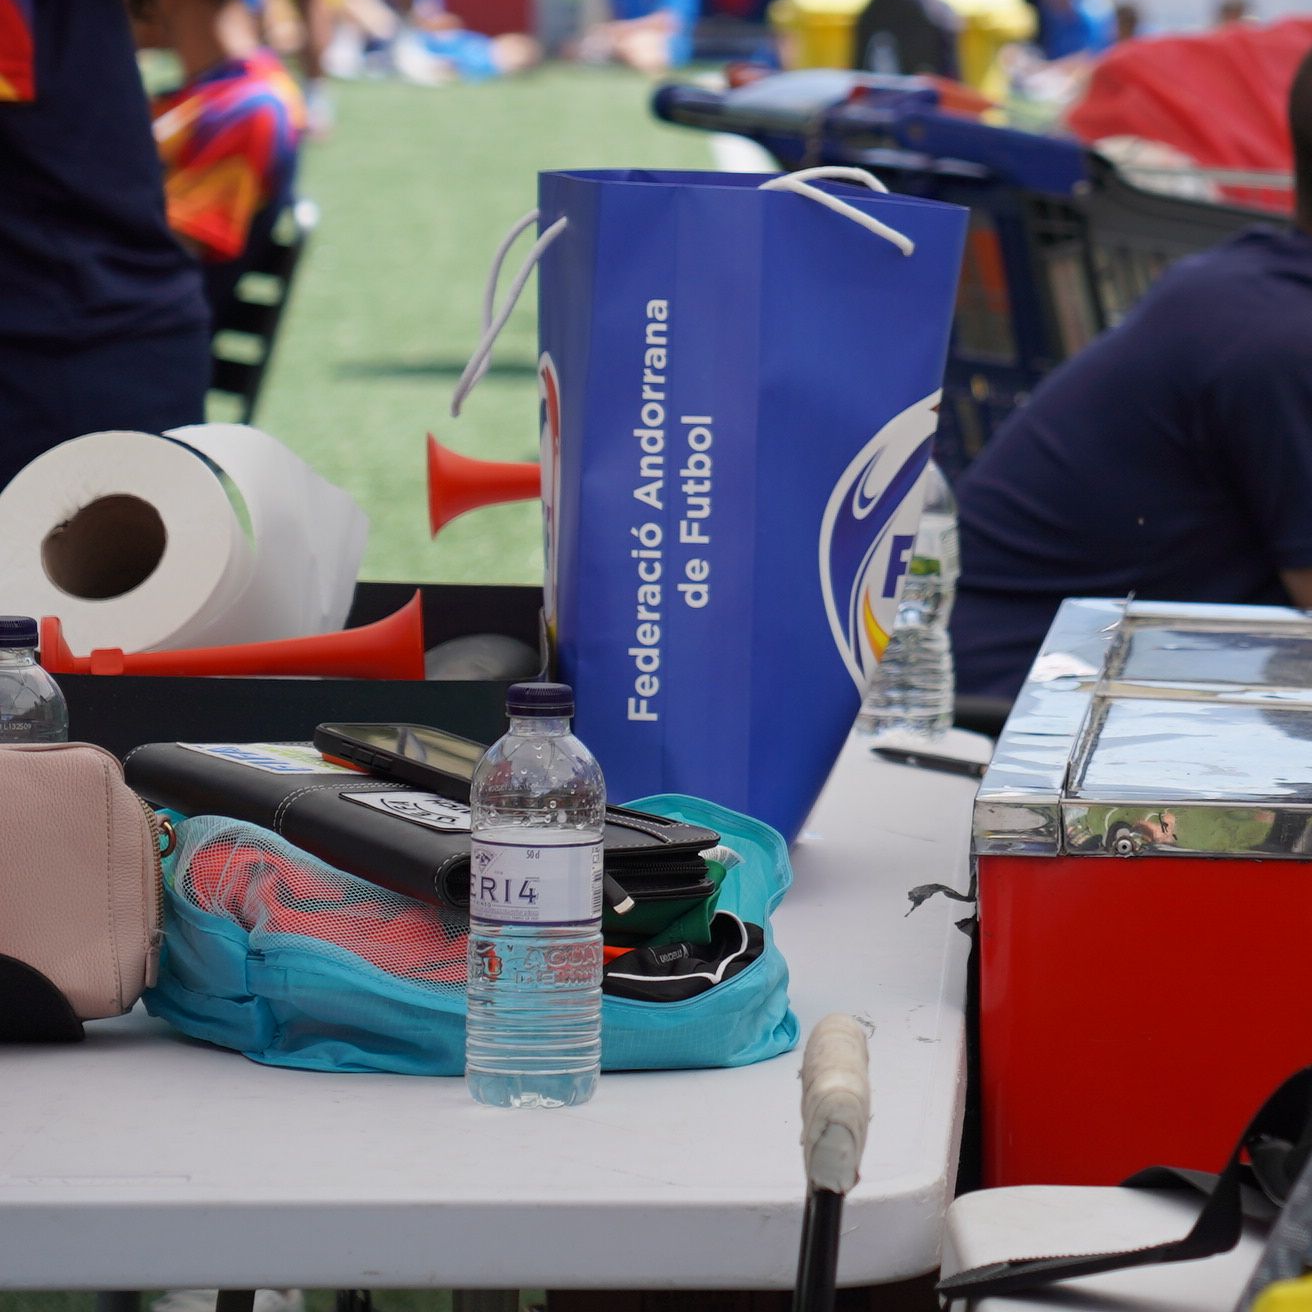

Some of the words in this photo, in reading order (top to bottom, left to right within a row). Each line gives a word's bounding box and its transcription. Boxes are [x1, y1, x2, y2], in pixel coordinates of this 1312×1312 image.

[633, 299, 668, 510] Andorrana
[679, 415, 712, 544] Futbol
[628, 522, 663, 721] Federació
[677, 558, 710, 609] de
